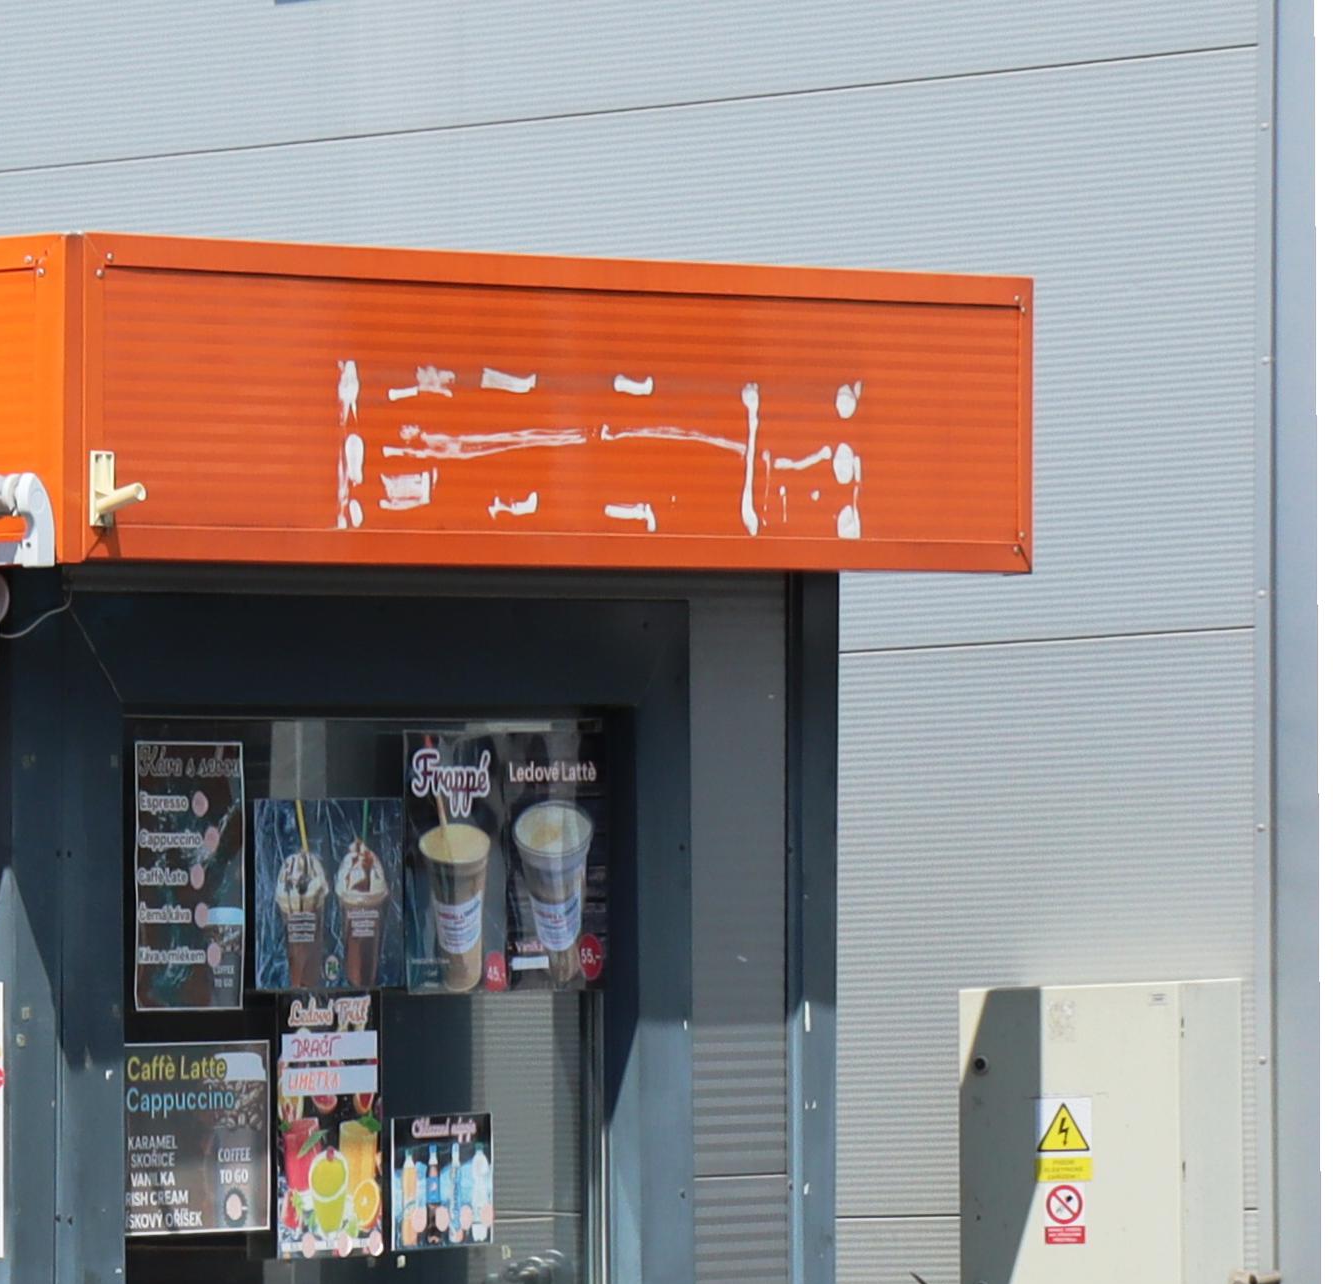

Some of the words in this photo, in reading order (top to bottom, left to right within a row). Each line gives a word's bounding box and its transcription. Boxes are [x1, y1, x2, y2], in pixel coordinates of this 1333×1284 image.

[509, 761, 559, 782] Ledové
[412, 749, 490, 817] Frappé
[139, 831, 202, 850] Cappuccino
[127, 1055, 176, 1081] Caffè
[180, 1055, 227, 1080] Latte
[126, 1087, 235, 1118] Cappuccino
[128, 1135, 178, 1150] KARAMEL
[130, 1150, 176, 1168] SKOŘICE
[218, 1148, 251, 1162] COFFEE
[220, 1169, 233, 1184] TO
[235, 1169, 249, 1184] GO
